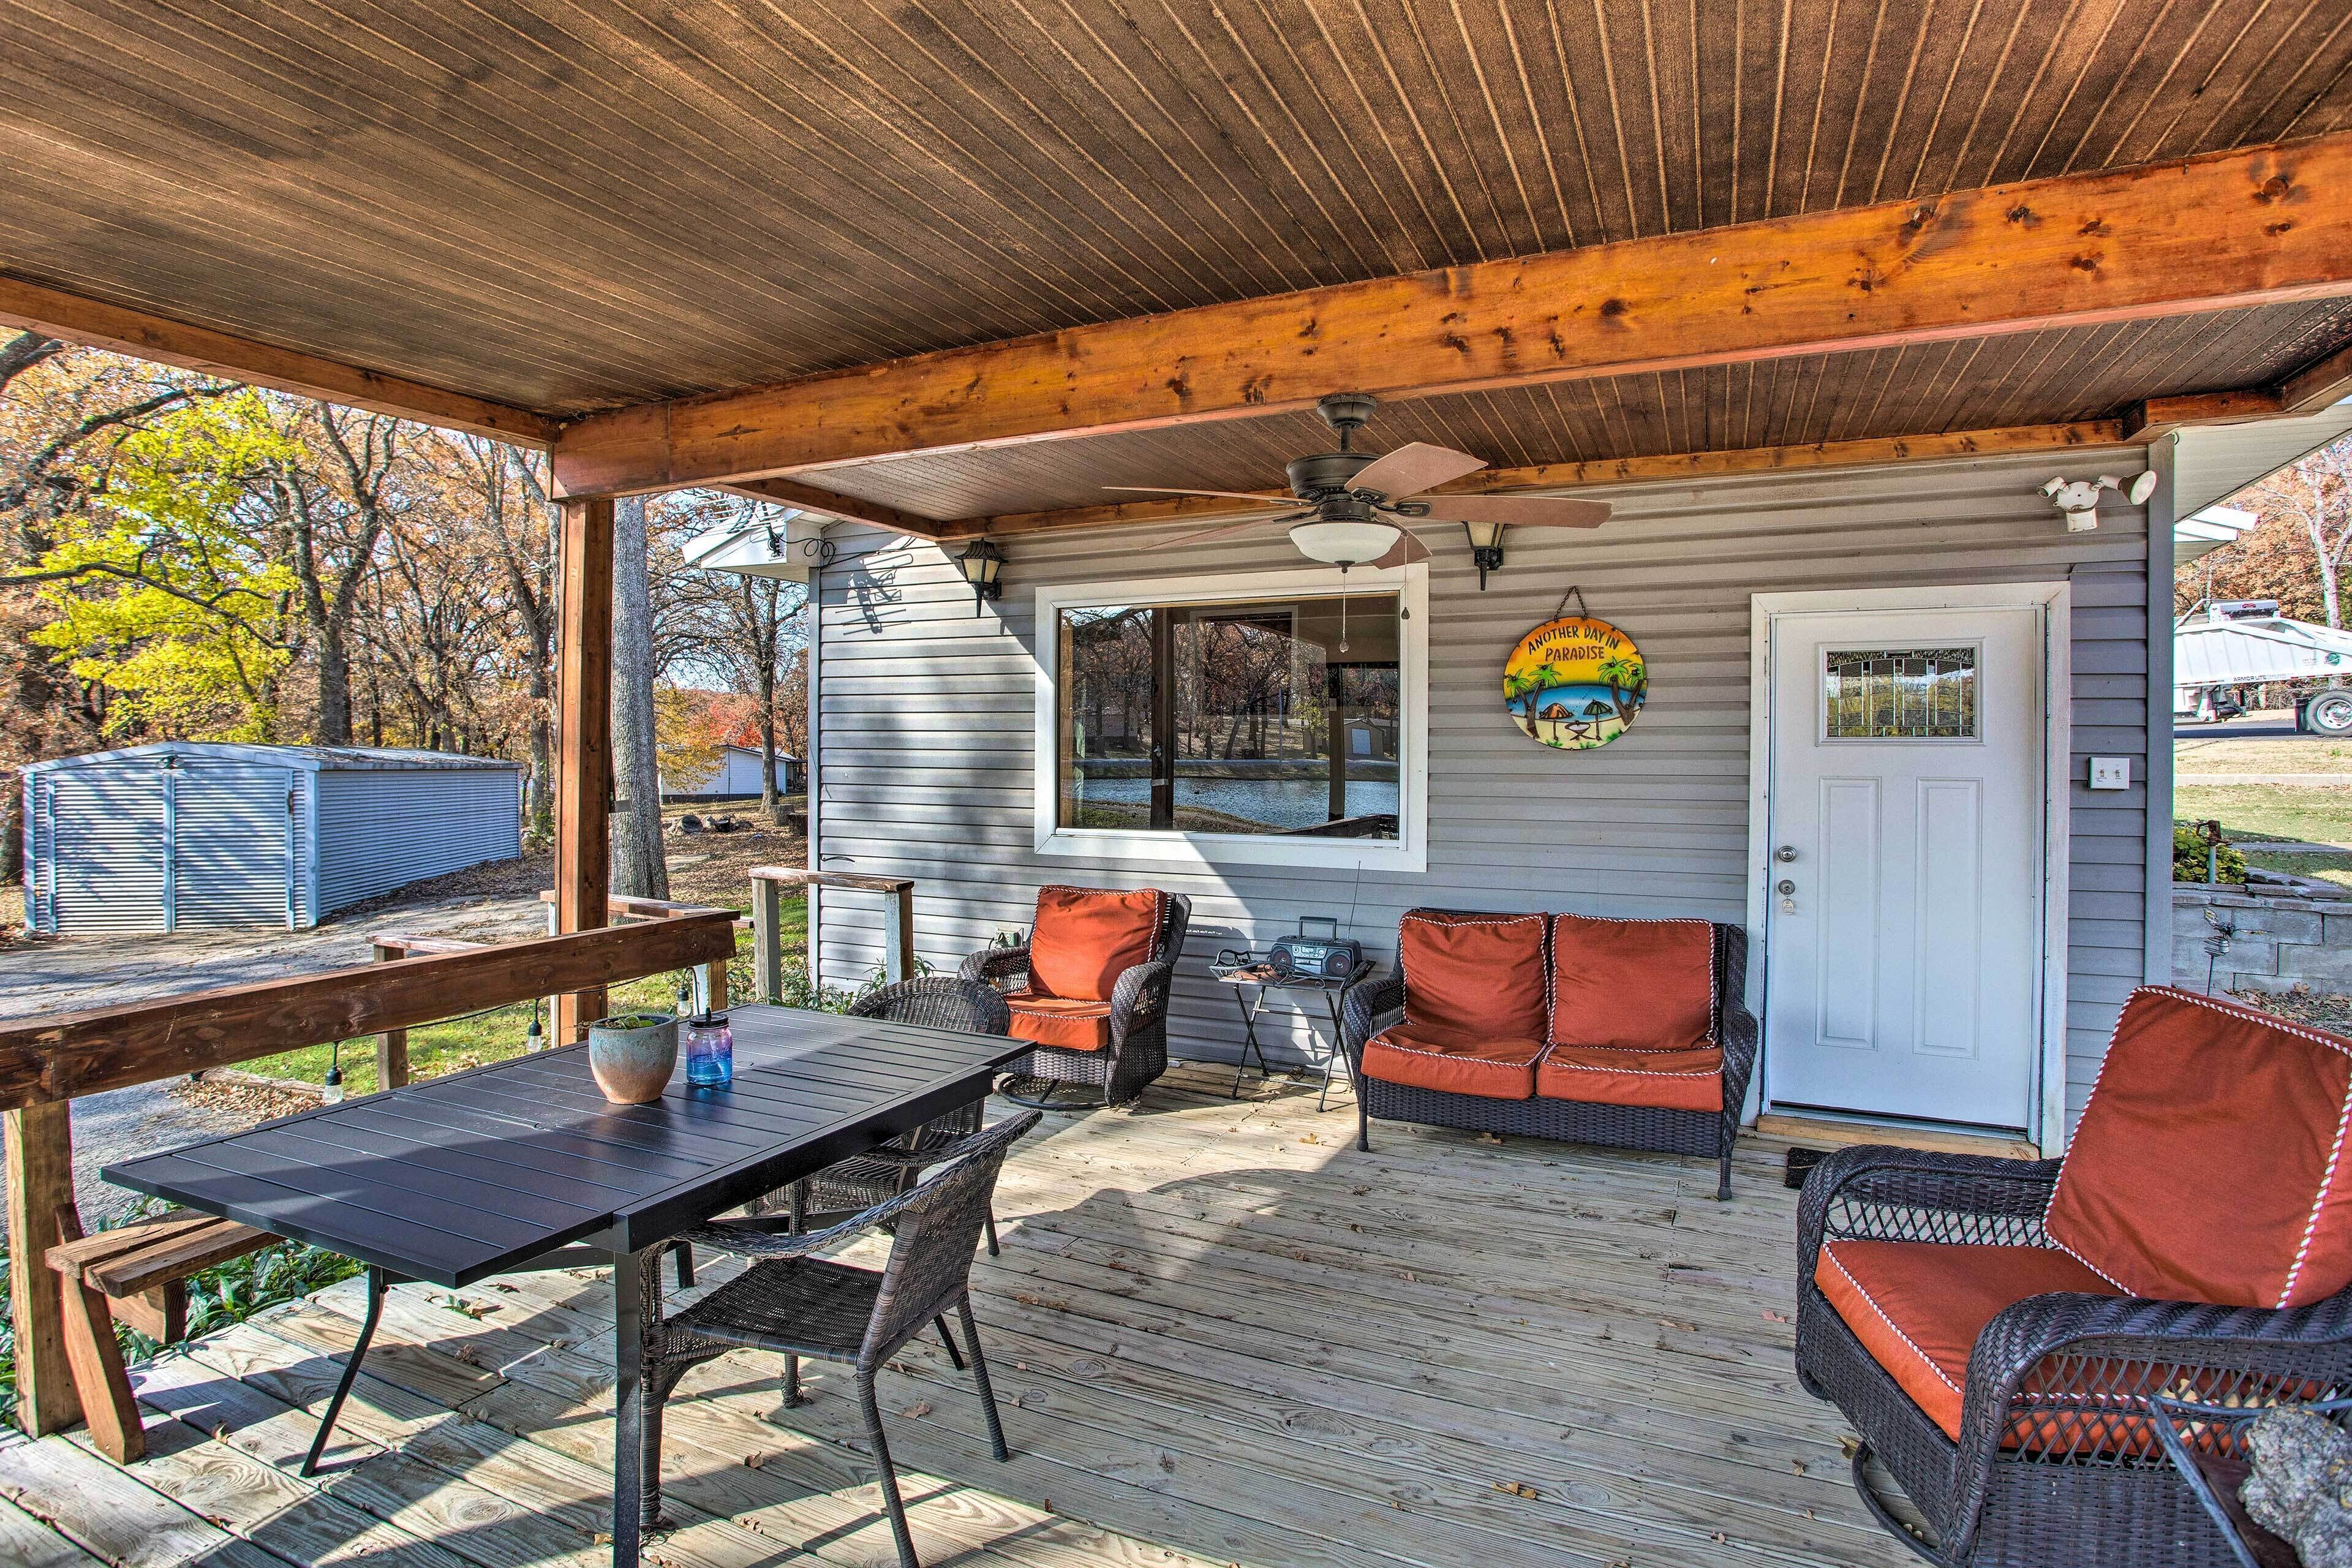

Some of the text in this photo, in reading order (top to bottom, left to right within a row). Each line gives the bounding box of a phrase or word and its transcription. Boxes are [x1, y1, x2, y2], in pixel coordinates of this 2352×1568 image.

[1528, 625, 1621, 655] ANOTHER DAY IN
[1545, 646, 1605, 662] PARADISE
